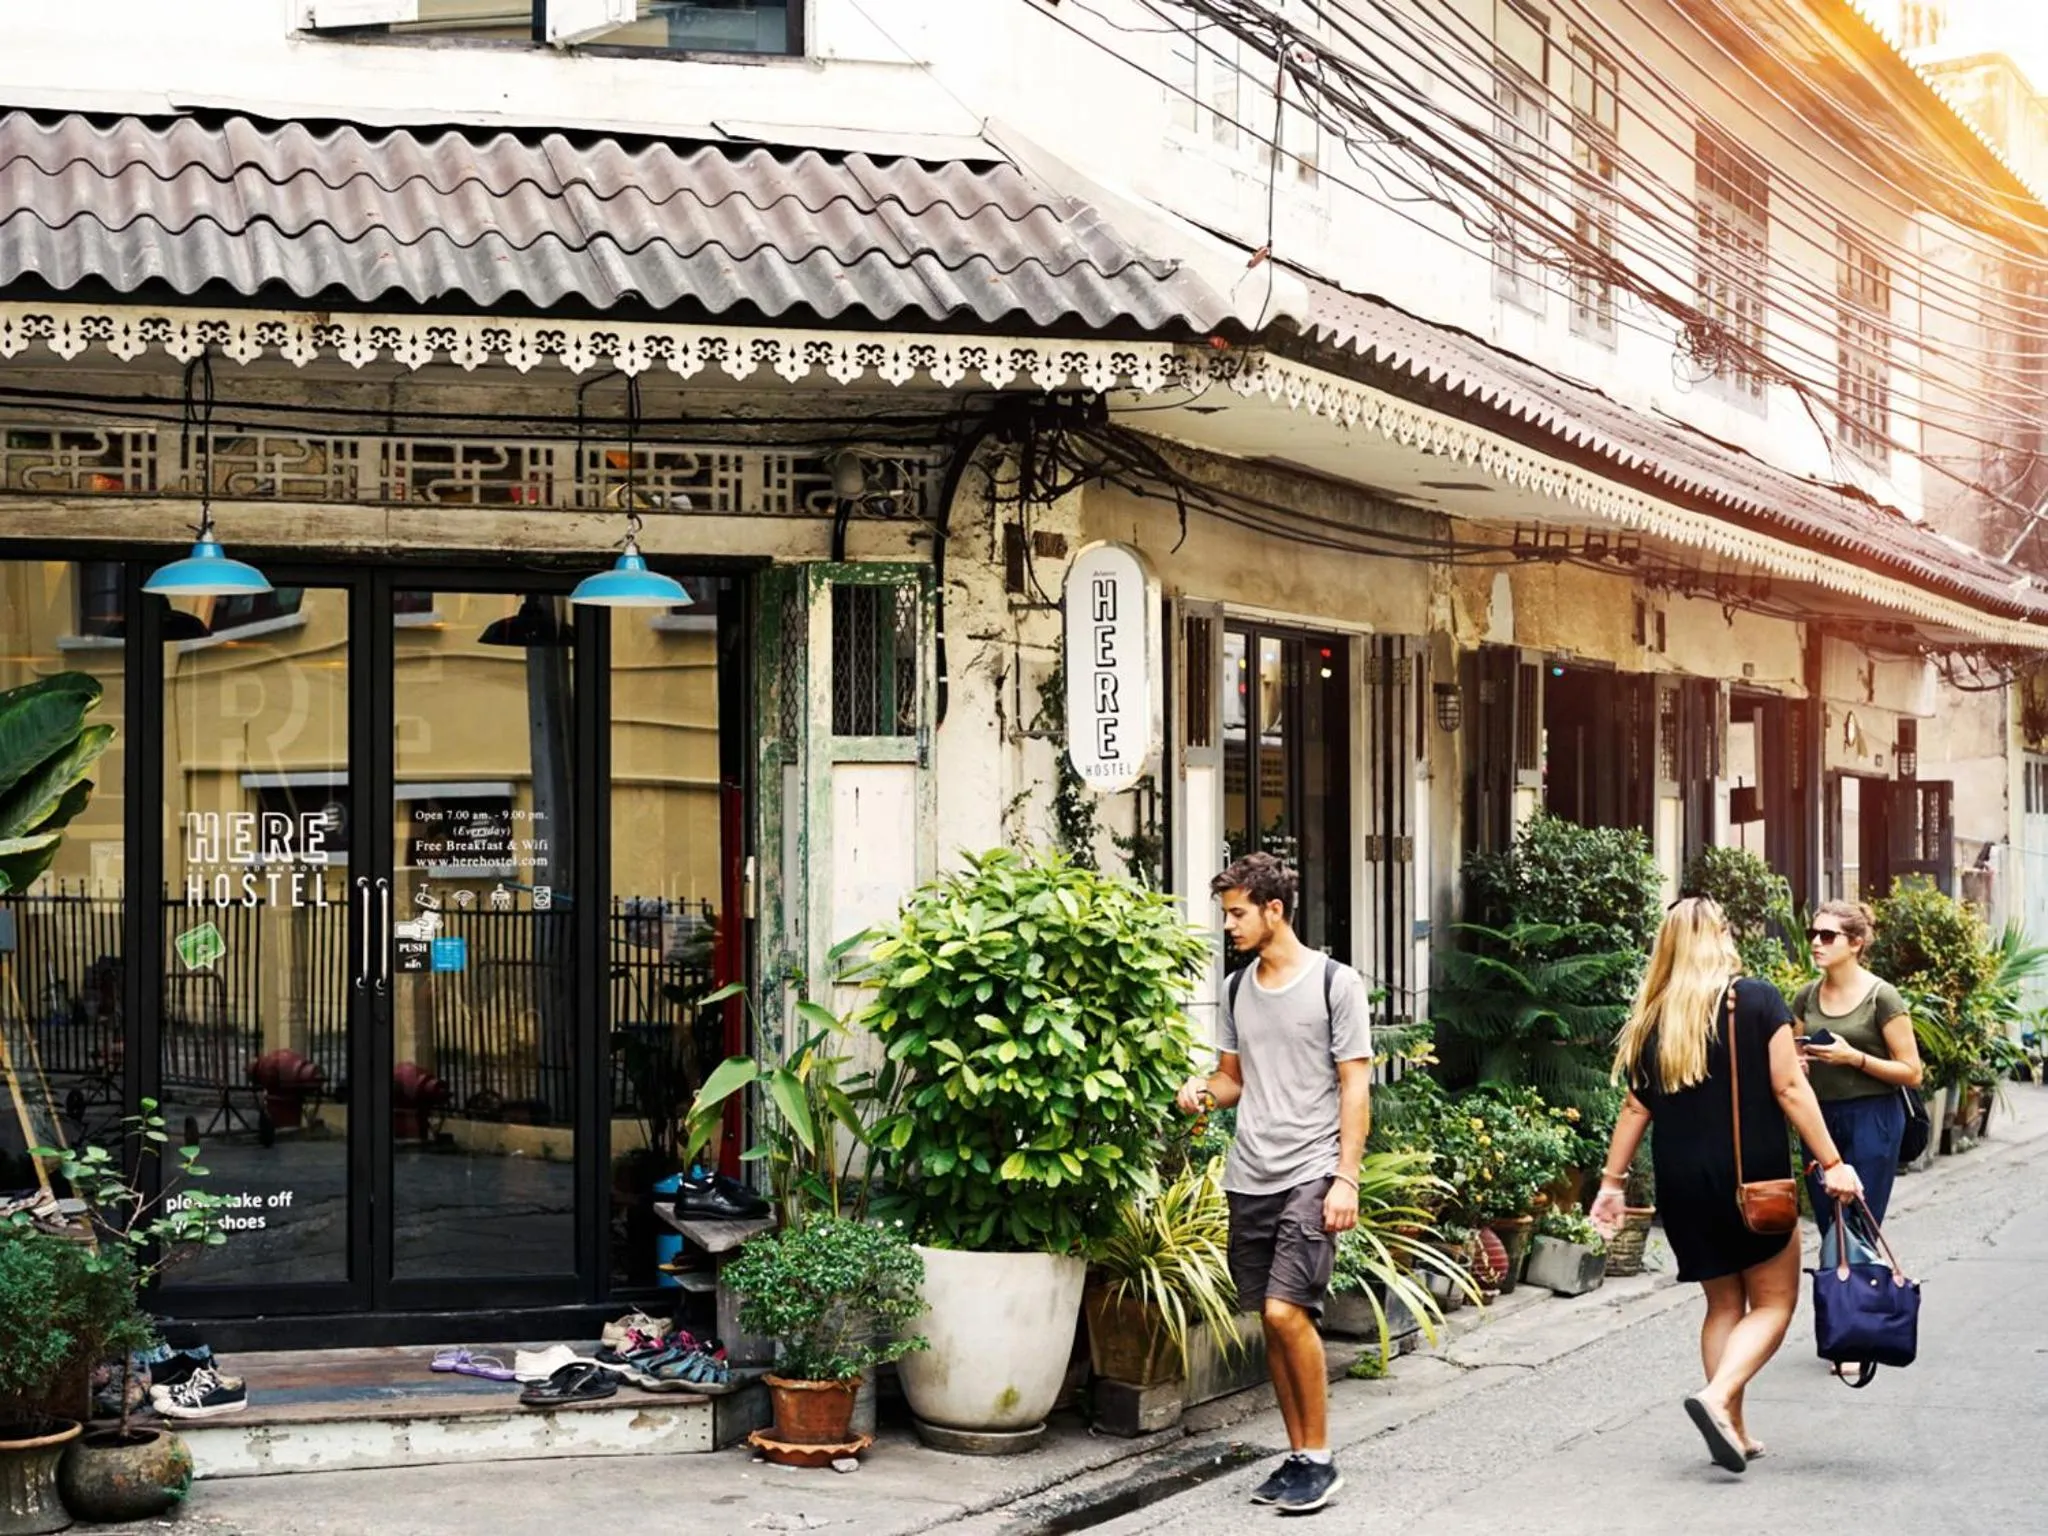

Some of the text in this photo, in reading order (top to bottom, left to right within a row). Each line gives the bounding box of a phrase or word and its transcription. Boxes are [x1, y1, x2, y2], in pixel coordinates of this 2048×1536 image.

[1091, 579, 1119, 760] HERE
[1085, 762, 1133, 777] HOSTEL
[415, 810, 443, 822] Open
[446, 810, 470, 820] 7.00
[472, 811, 492, 820] am.
[501, 810, 526, 820] 9.00
[528, 811, 548, 821] pm.
[187, 812, 329, 863] HERE
[415, 839, 548, 851] Free Breakfast & Wifi
[415, 856, 548, 867] www.herehostel.com
[187, 873, 329, 908] HOSTEL
[399, 943, 427, 953] PUSH
[267, 1191, 293, 1207] off
[217, 1214, 267, 1230] shoes
